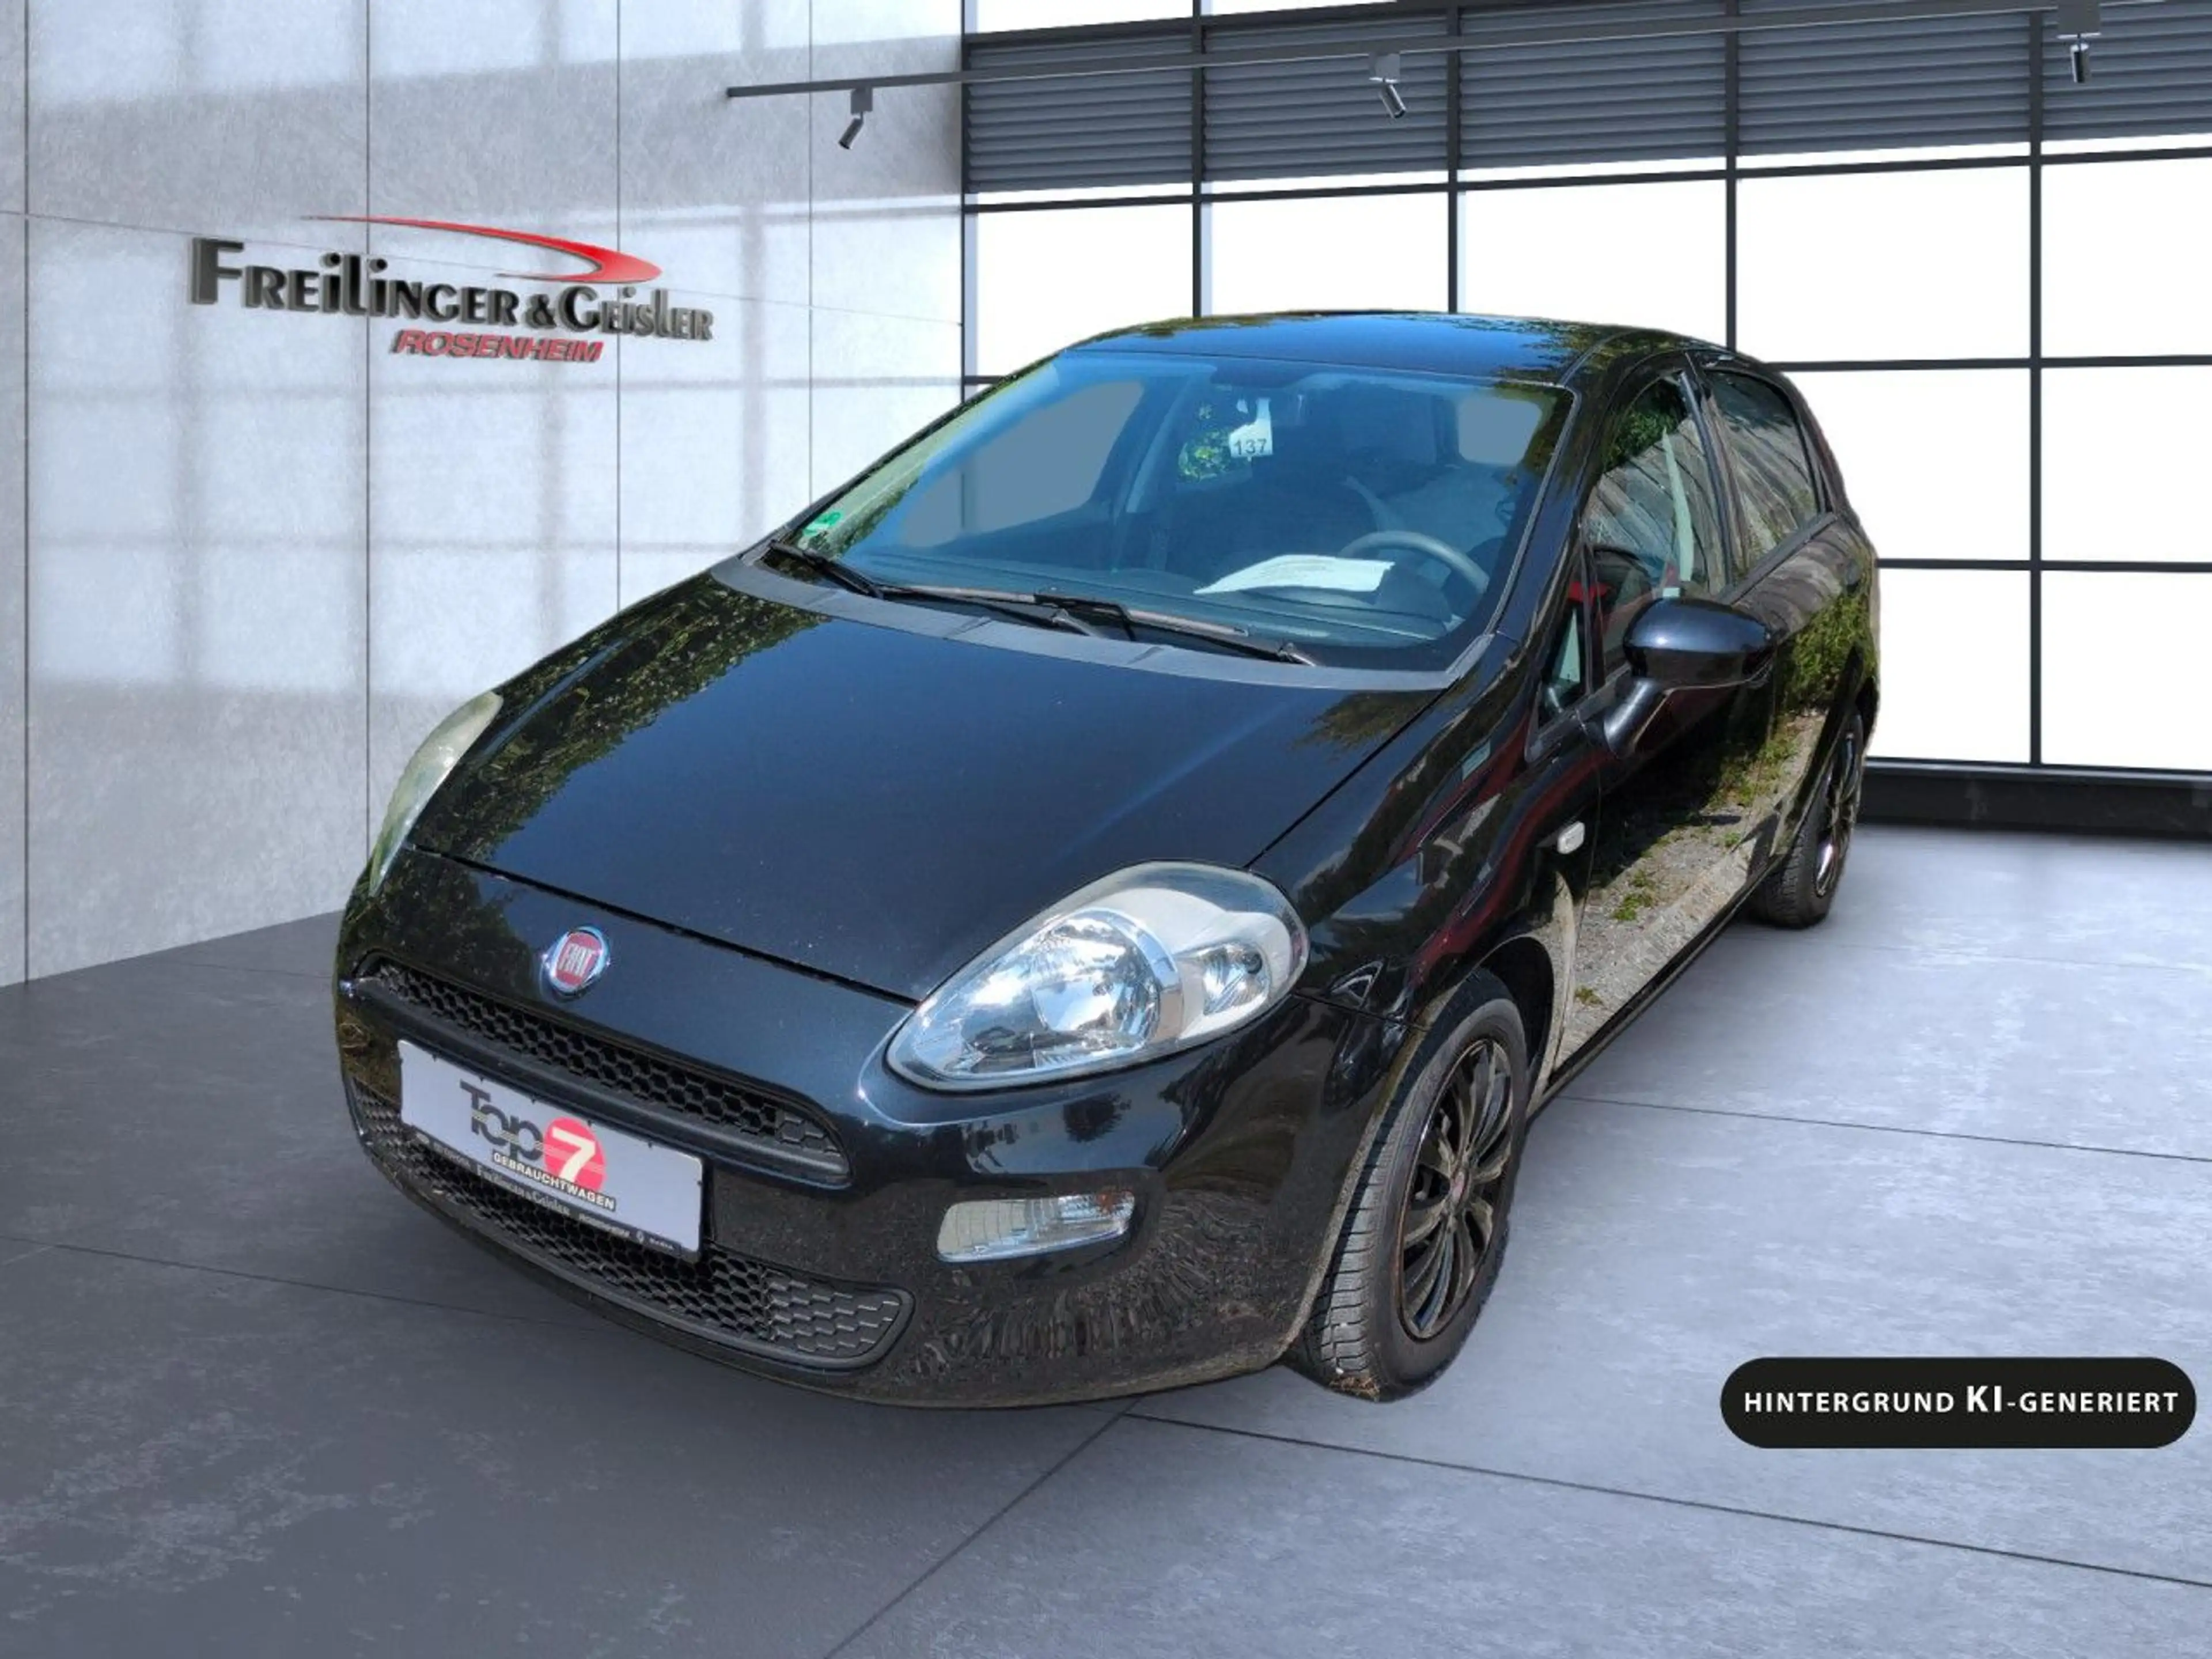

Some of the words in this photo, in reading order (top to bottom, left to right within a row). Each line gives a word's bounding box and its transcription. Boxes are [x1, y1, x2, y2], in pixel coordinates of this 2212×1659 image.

[524, 293, 557, 329] &
[390, 329, 604, 362] ROSENHEIM
[1233, 438, 1268, 455] 137
[494, 1152, 614, 1210] GEBRAUCHTWAGEN
